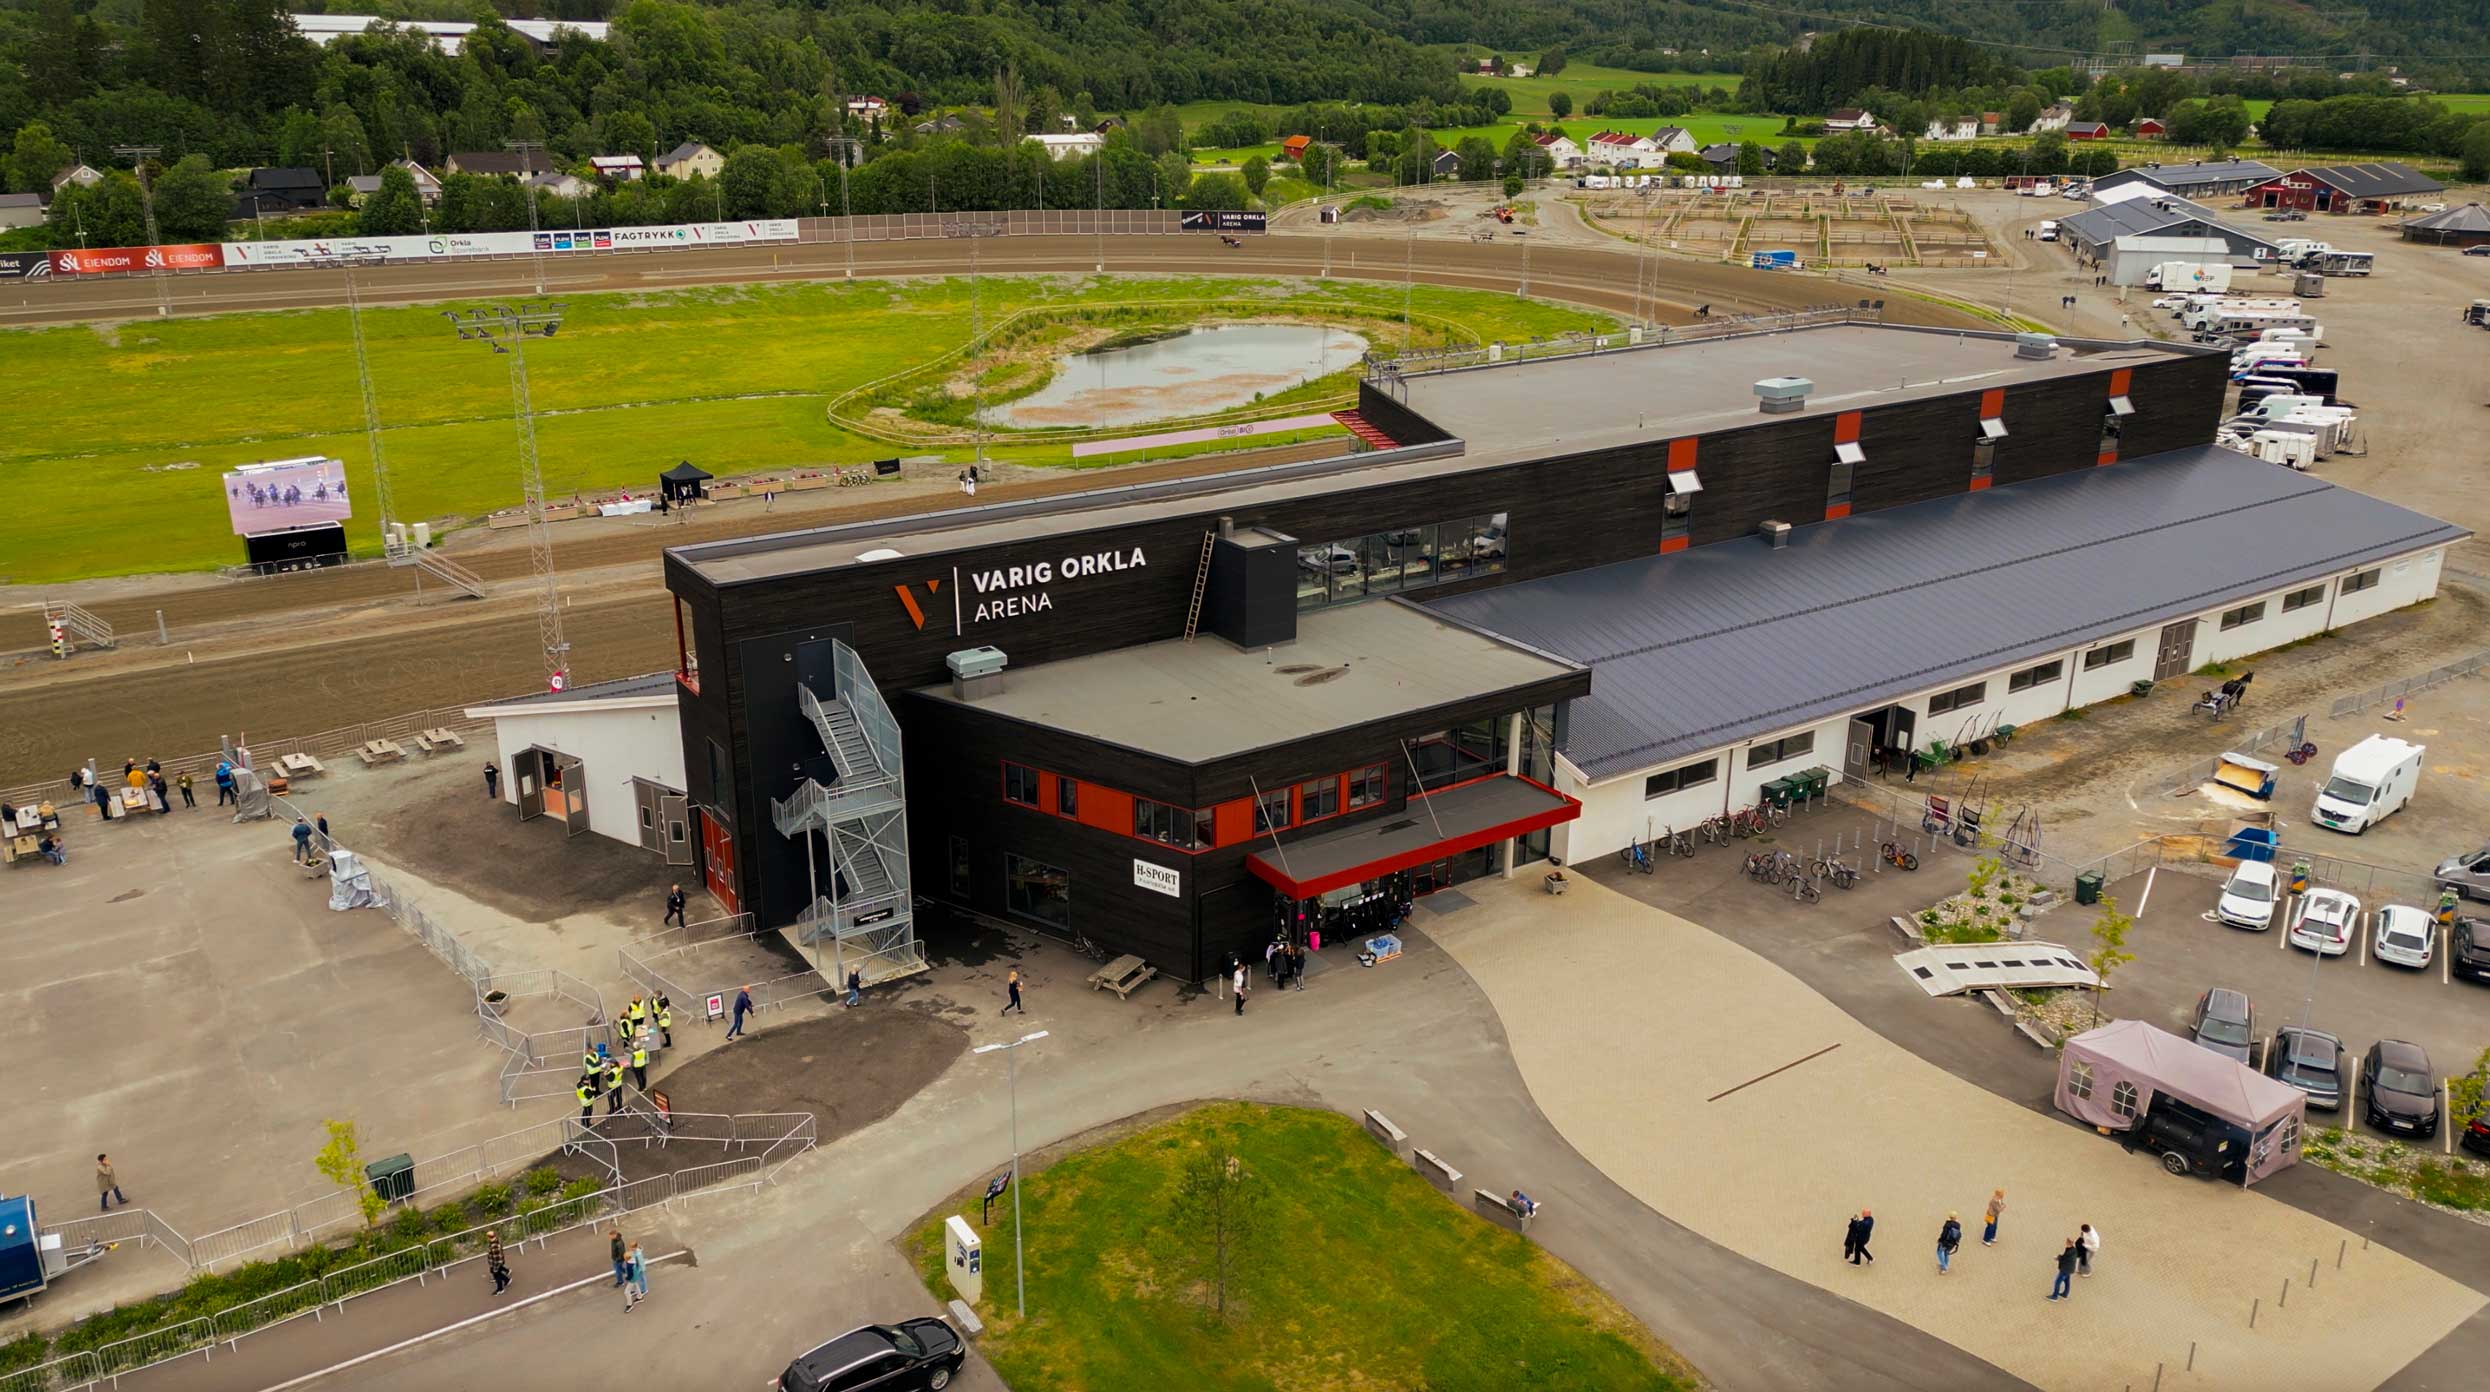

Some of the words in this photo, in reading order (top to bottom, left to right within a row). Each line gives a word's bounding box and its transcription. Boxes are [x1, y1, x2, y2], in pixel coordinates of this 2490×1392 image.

[614, 230, 674, 241] FAGTRYKK
[450, 239, 472, 247] Orkla
[169, 252, 214, 264] EIENDOM
[2257, 249, 2264, 257] 1
[83, 256, 131, 268] EIENDOM
[971, 562, 1052, 594] VARIG
[1060, 547, 1147, 579] ORKLA
[974, 592, 1053, 623] ARENA
[1136, 864, 1178, 885] H-SPORT
